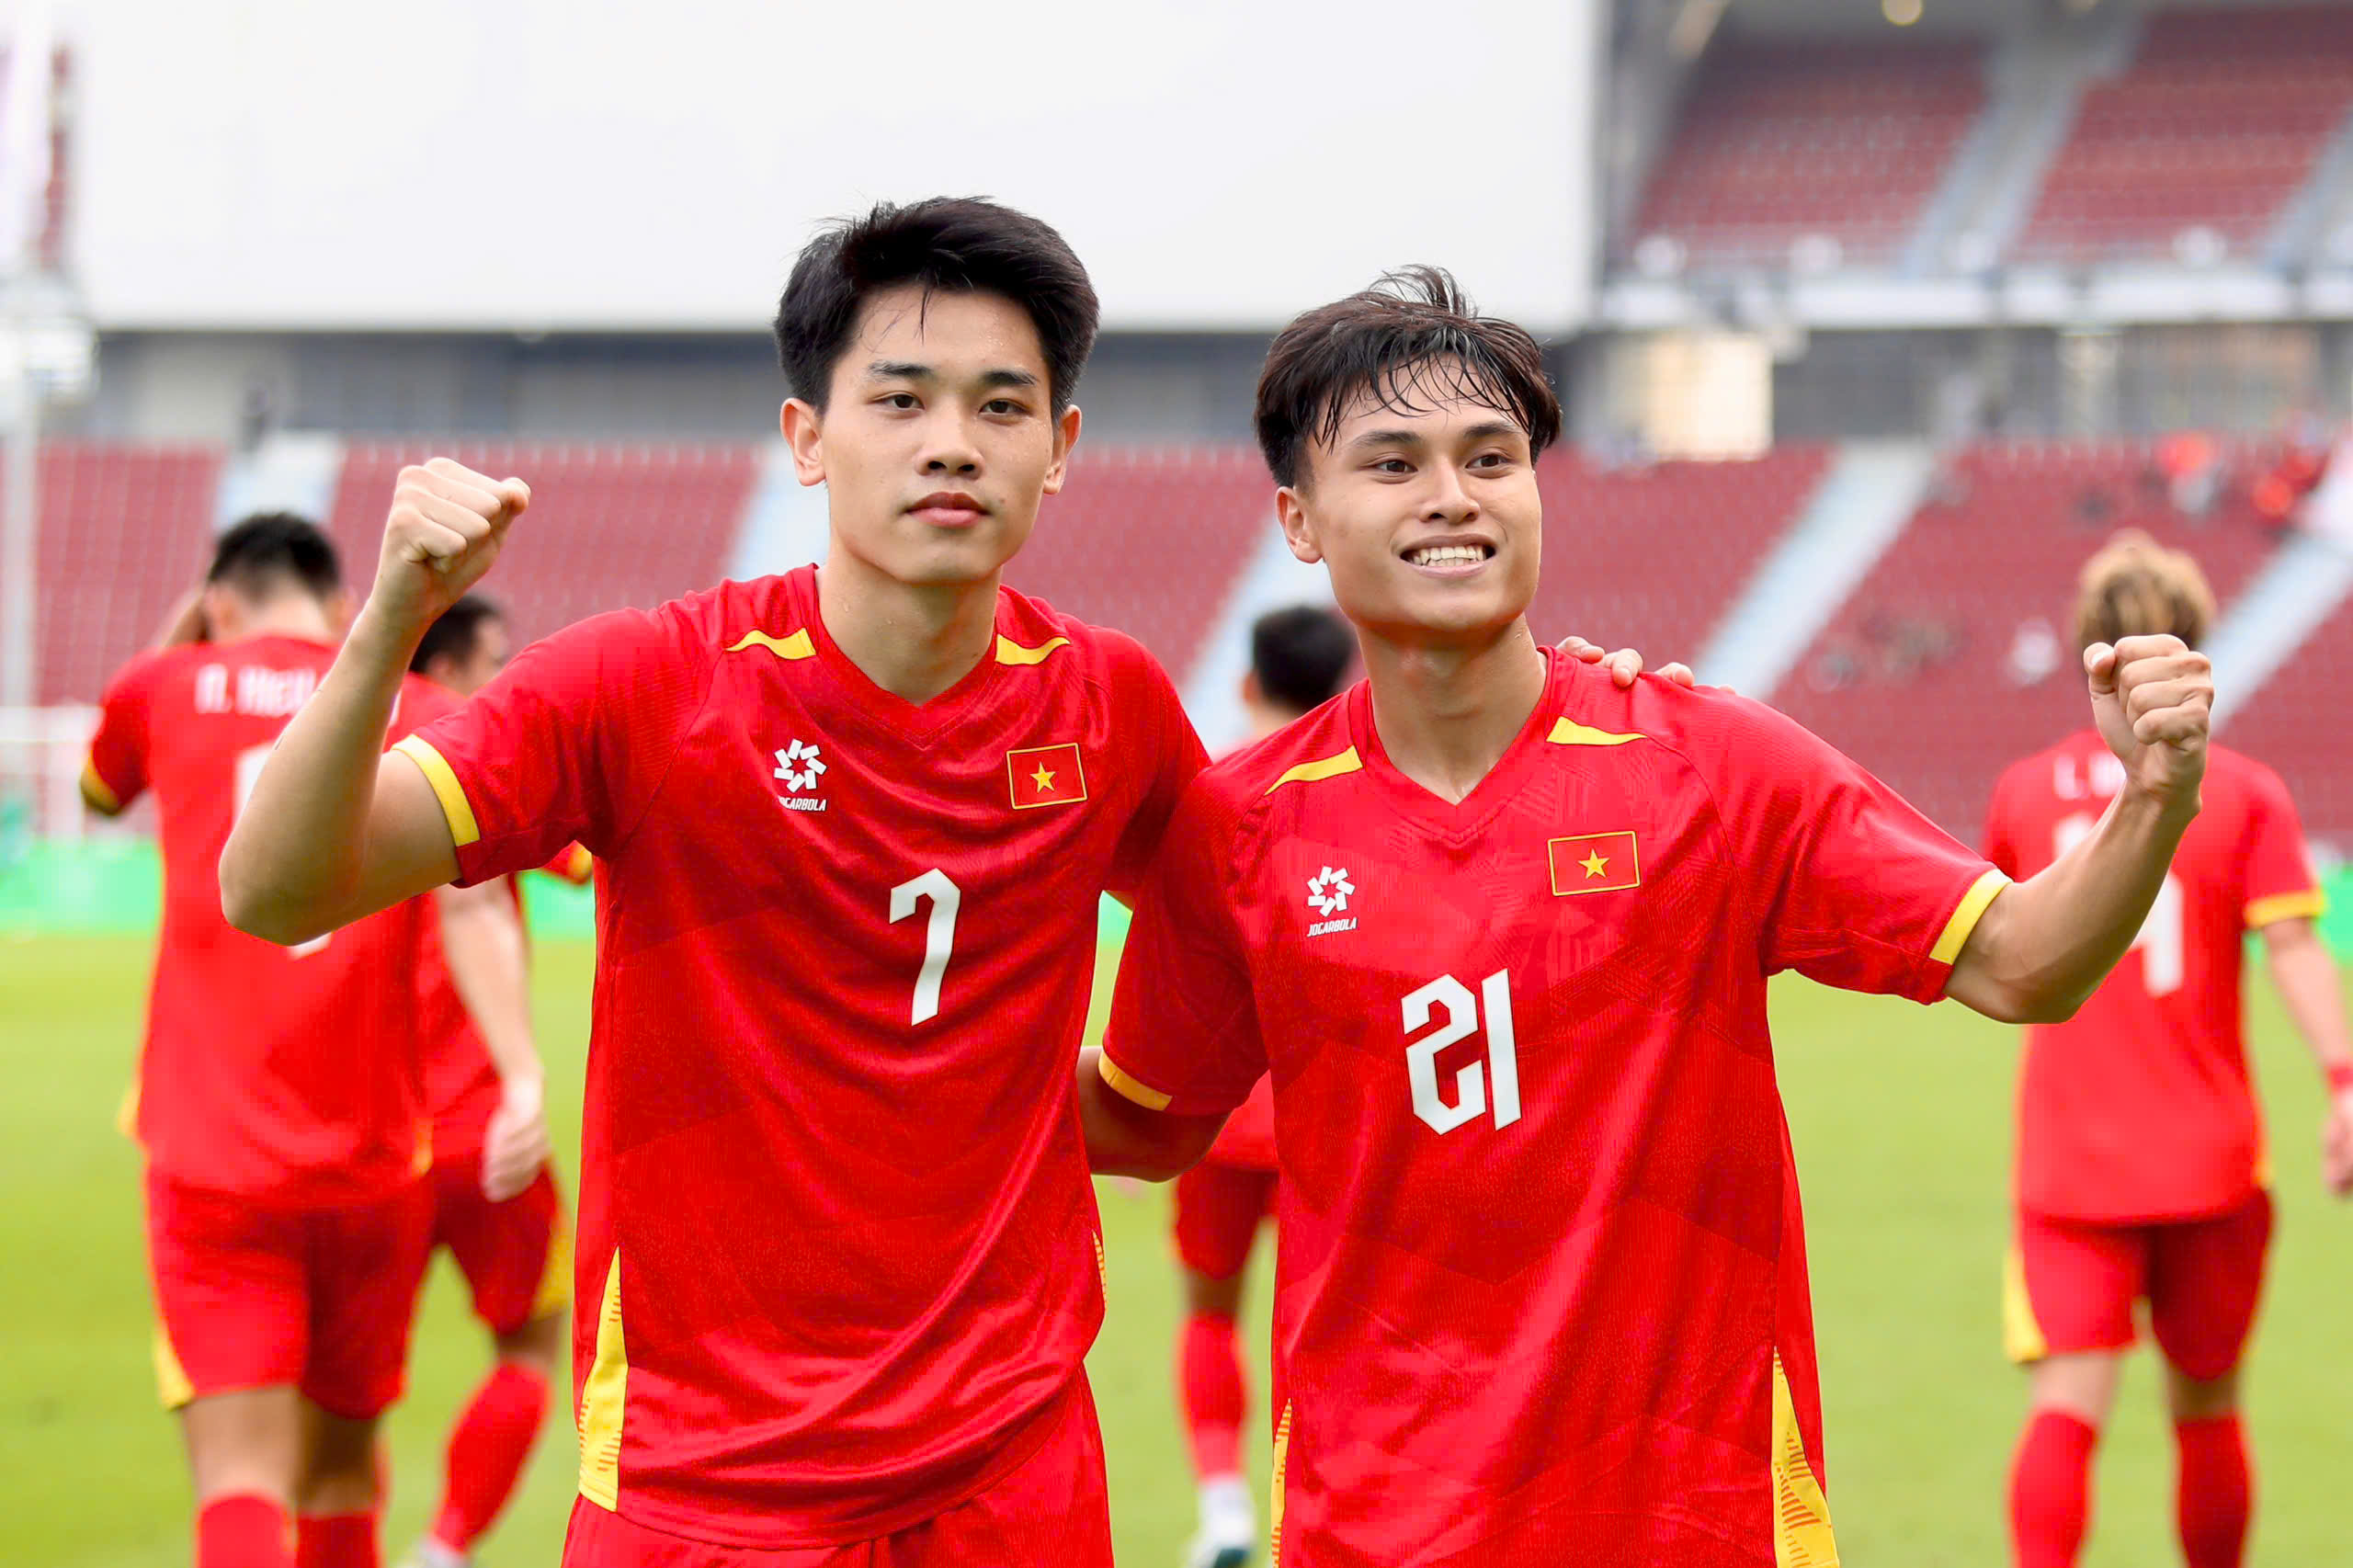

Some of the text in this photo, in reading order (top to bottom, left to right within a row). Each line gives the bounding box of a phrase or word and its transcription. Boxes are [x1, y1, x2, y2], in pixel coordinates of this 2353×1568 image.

[890, 868, 961, 1027] 7
[1306, 917, 1358, 937] JOGARBOLA
[1401, 968, 1522, 1135] 21
